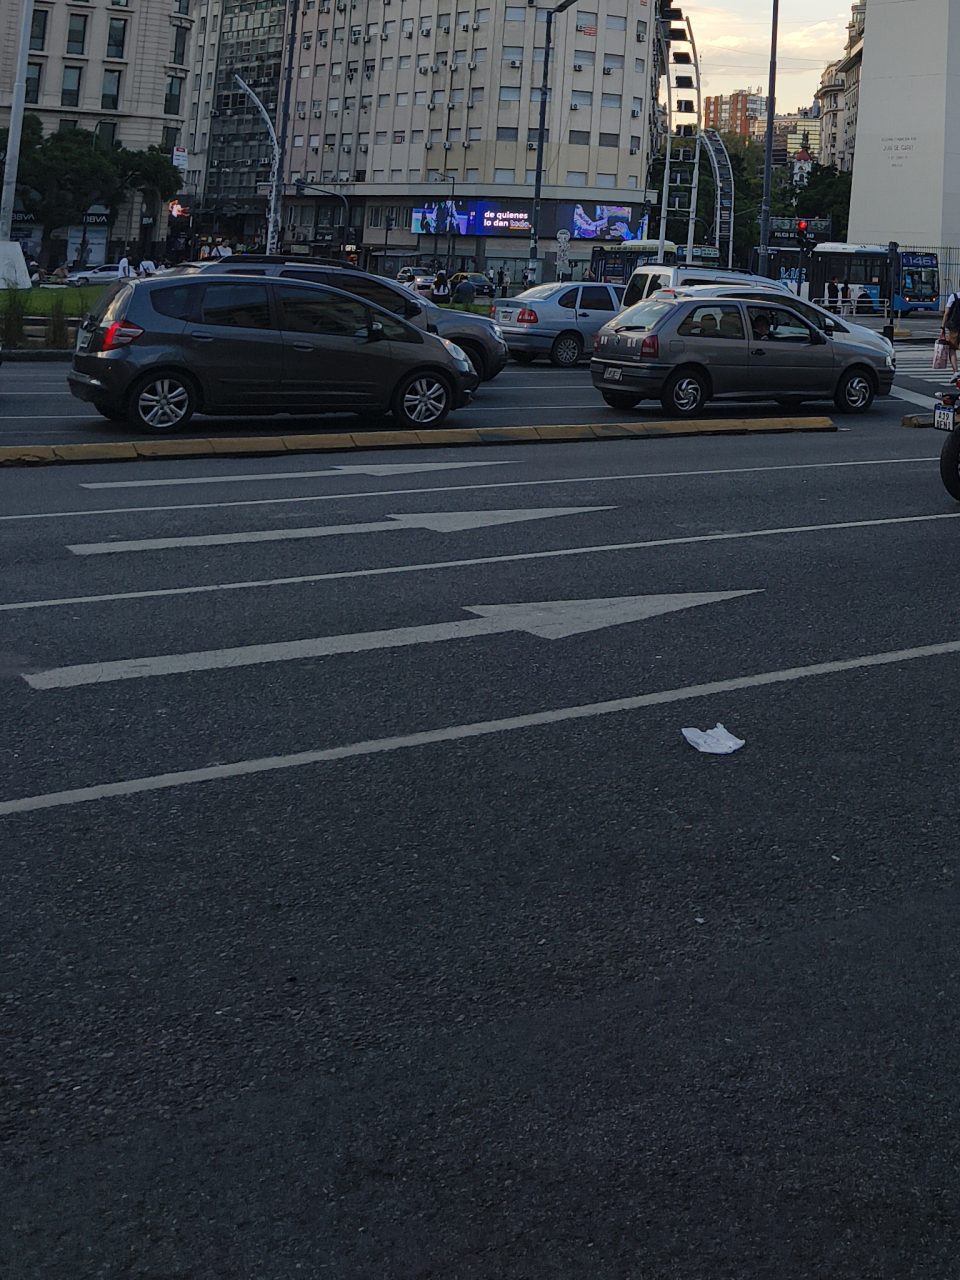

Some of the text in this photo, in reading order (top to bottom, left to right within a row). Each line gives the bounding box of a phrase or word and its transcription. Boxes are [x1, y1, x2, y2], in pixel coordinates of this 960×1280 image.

[496, 211, 528, 220] quienes
[483, 218, 492, 227] lo
[493, 219, 508, 227] dan
[909, 256, 932, 266] 146
